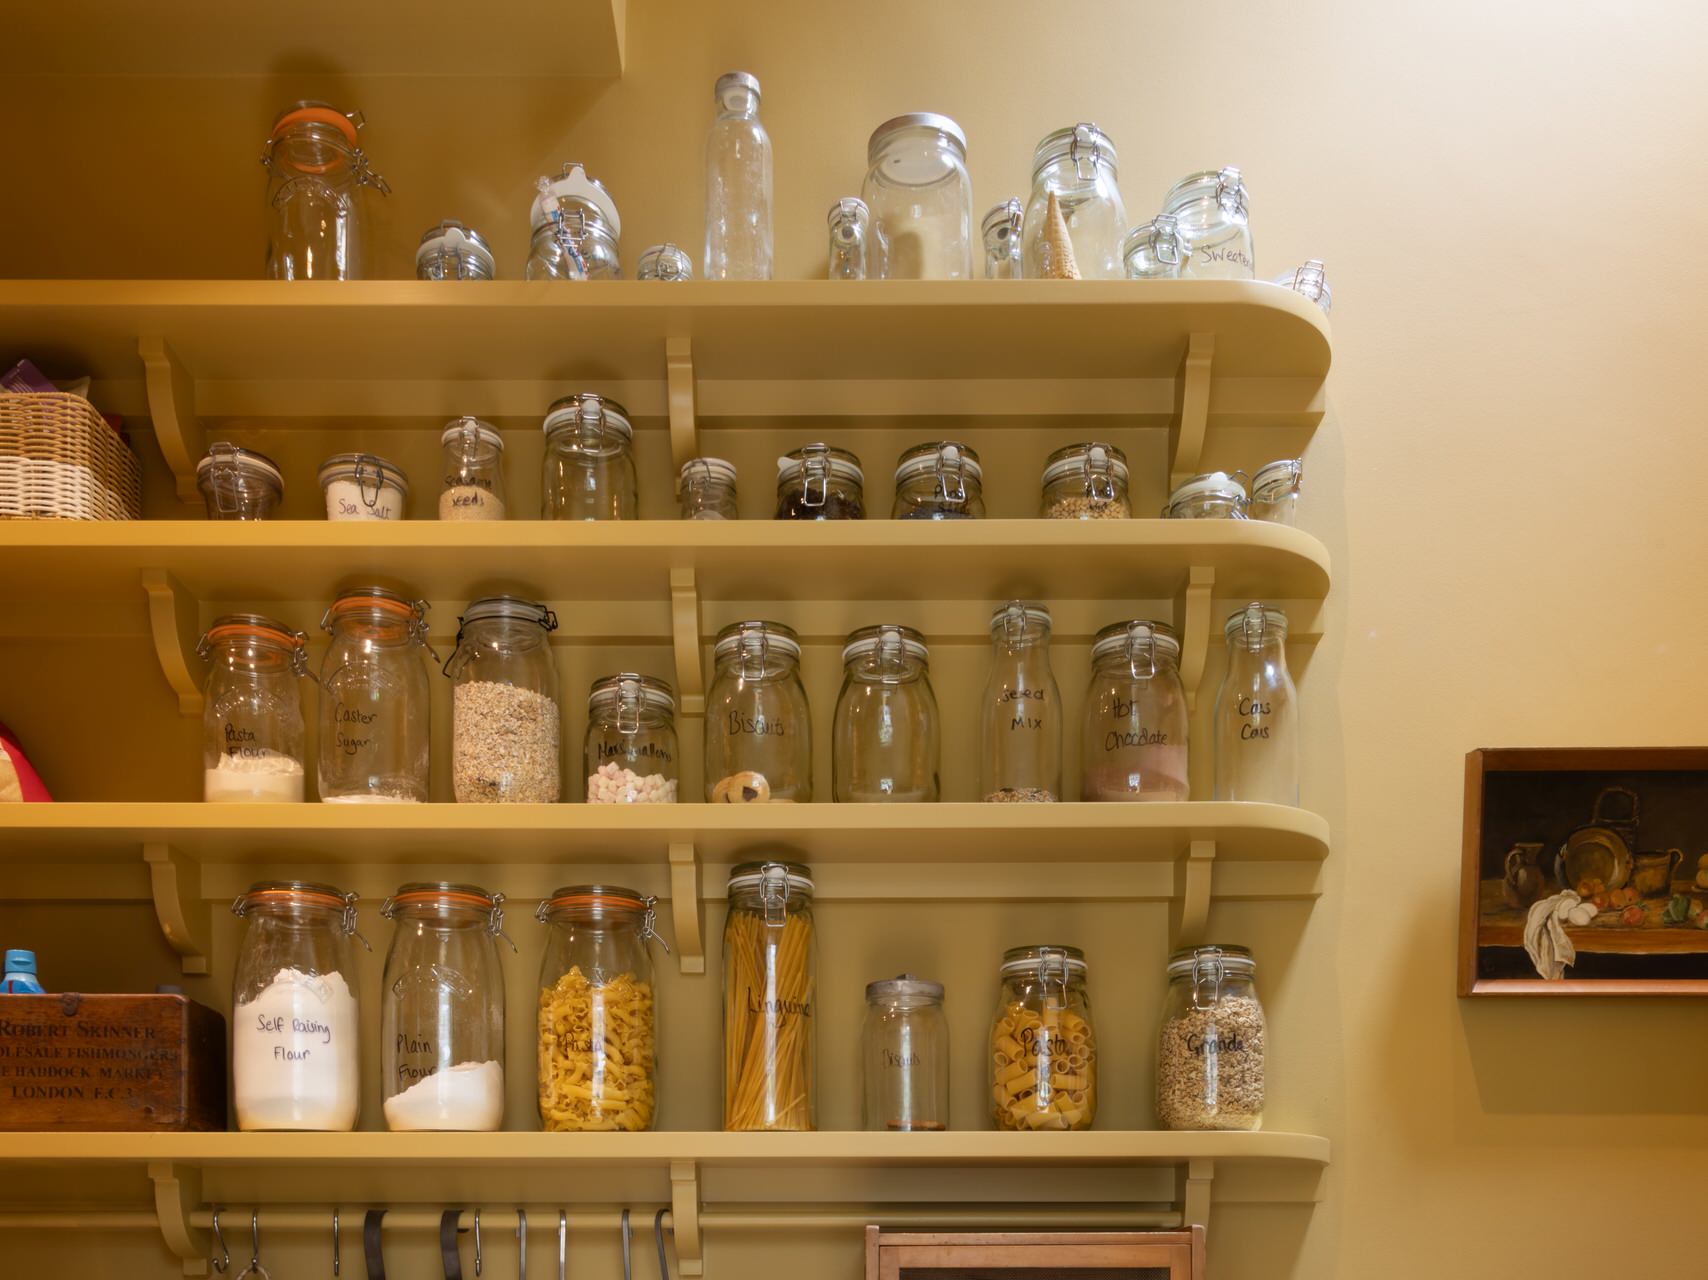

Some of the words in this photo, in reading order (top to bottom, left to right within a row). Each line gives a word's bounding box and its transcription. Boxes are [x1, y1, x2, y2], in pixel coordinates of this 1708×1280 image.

[338, 498, 358, 515] Sea
[369, 500, 392, 520] Salt
[334, 702, 378, 724] Caster
[1111, 697, 1135, 720] Hot
[225, 723, 256, 743] Pasta
[729, 710, 785, 737] Biscuits
[336, 733, 372, 756] Sugar
[76, 1020, 156, 1039] SKINNER
[256, 1014, 285, 1032] Self
[292, 1018, 331, 1044] Raising
[273, 1046, 311, 1061] Flour
[397, 1034, 433, 1053] Plain
[15, 1065, 91, 1078] HADDOCK
[12, 1085, 85, 1098] LONDON
